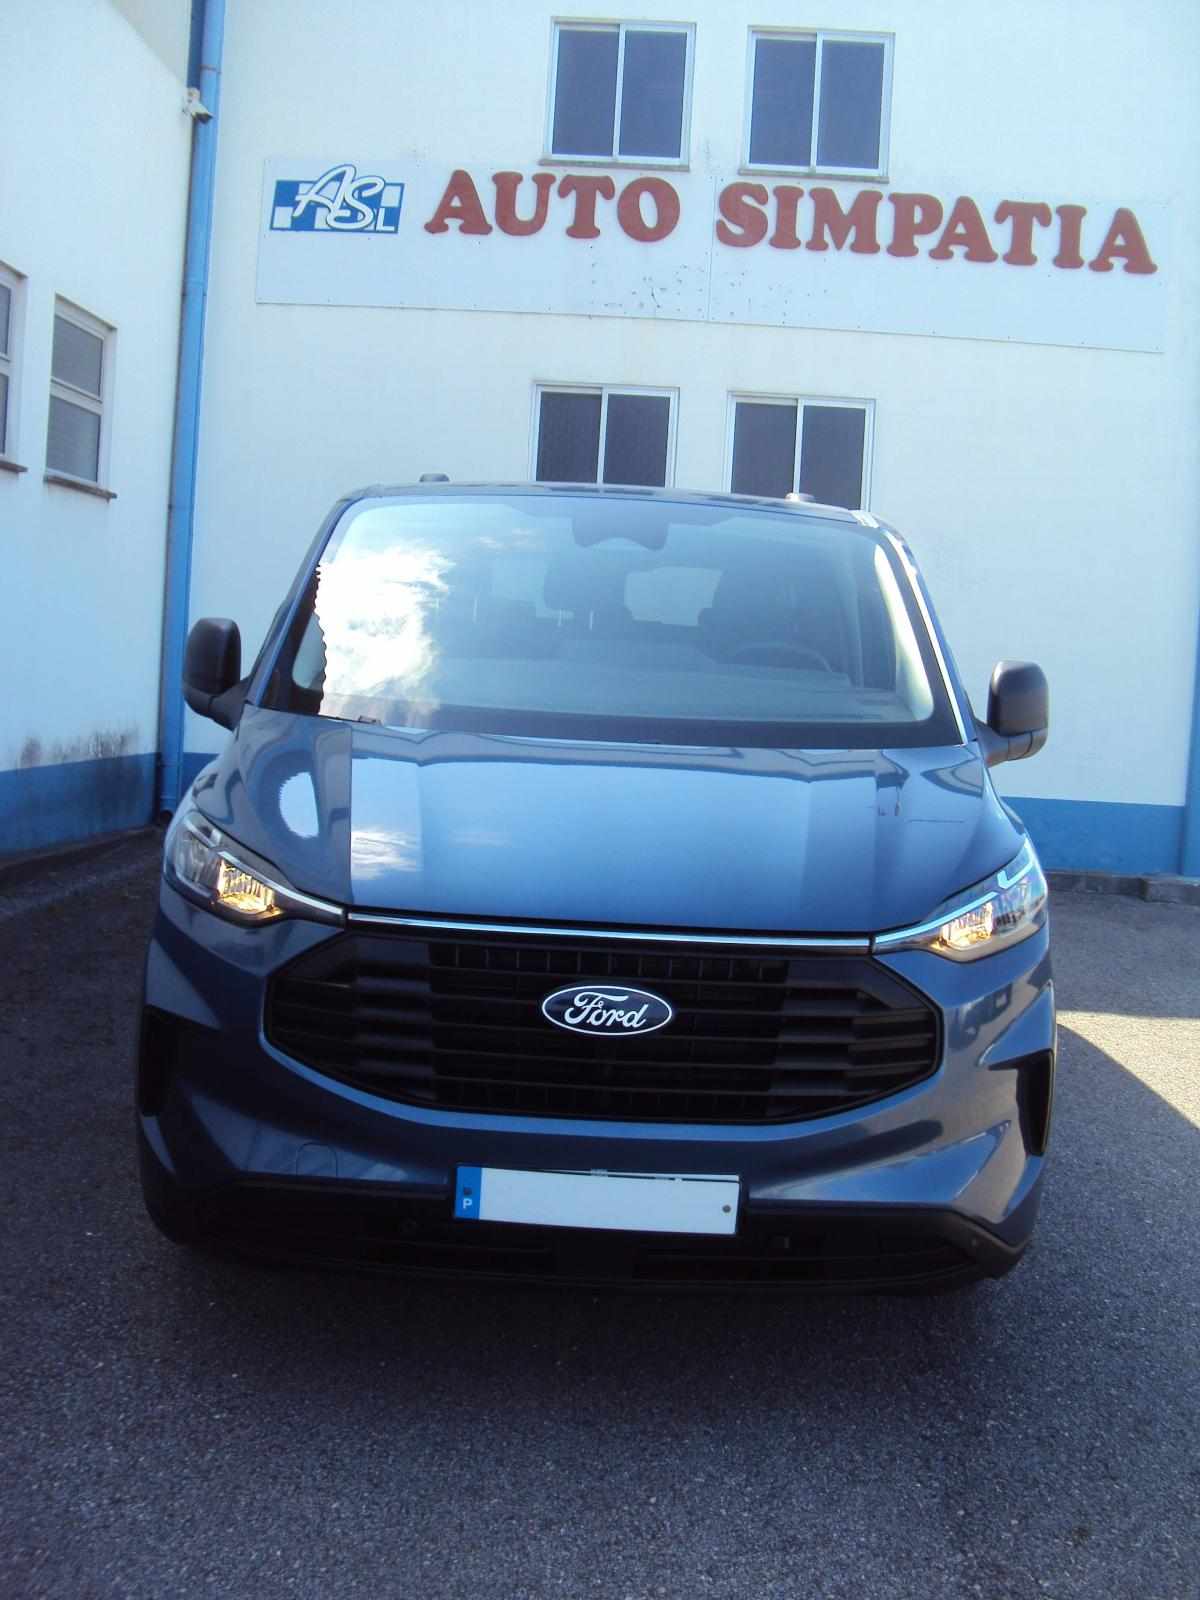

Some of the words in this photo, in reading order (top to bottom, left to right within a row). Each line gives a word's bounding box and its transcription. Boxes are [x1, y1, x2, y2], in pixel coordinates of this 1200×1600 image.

[424, 169, 681, 242] AUTO
[716, 182, 1158, 275] SIMPATIA
[564, 991, 649, 1028] Ford
[462, 1198, 473, 1209] P
